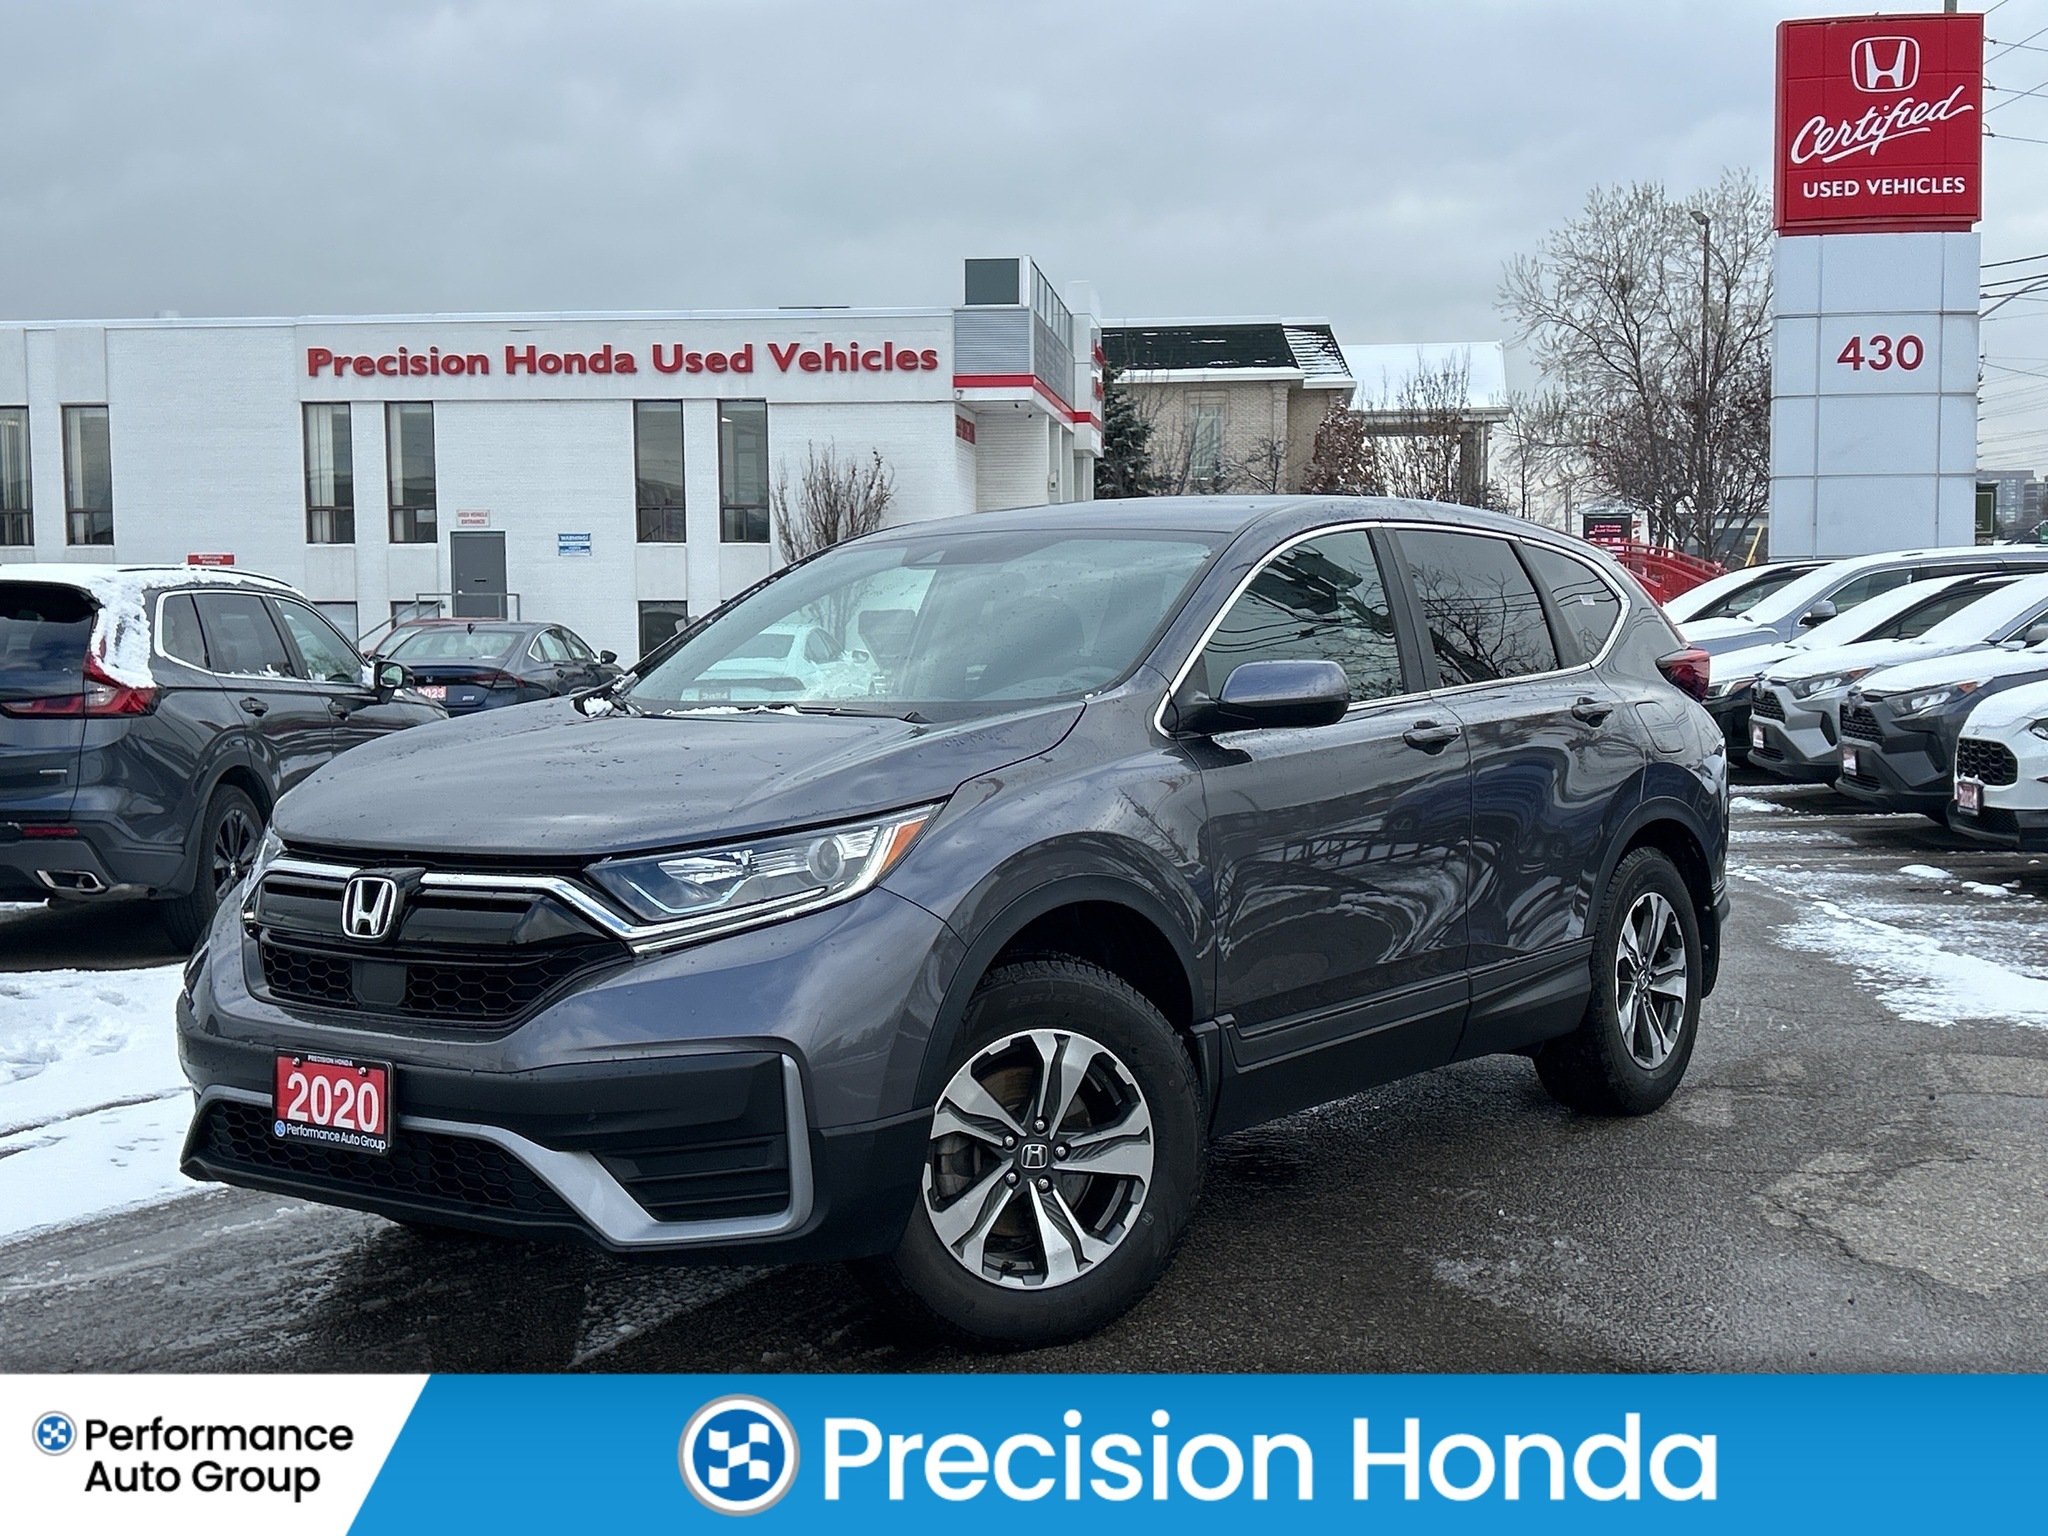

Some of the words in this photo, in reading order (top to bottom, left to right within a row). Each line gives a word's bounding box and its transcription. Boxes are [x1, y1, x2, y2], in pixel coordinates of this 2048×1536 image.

[1790, 85, 1974, 164] Certified
[1803, 180, 1860, 198] USED
[1866, 177, 1966, 195] VEHICLES
[307, 347, 490, 377] Precision
[505, 344, 638, 375] Honda
[652, 343, 754, 374] Used
[767, 341, 938, 373] Vehicles
[1838, 335, 1924, 371] 430
[307, 1054, 334, 1065] PRECISION
[334, 1058, 353, 1067] HONDA
[287, 1072, 380, 1133] 2020
[286, 1123, 340, 1142] Performance
[340, 1132, 360, 1146] Auto
[360, 1135, 386, 1153] Group
